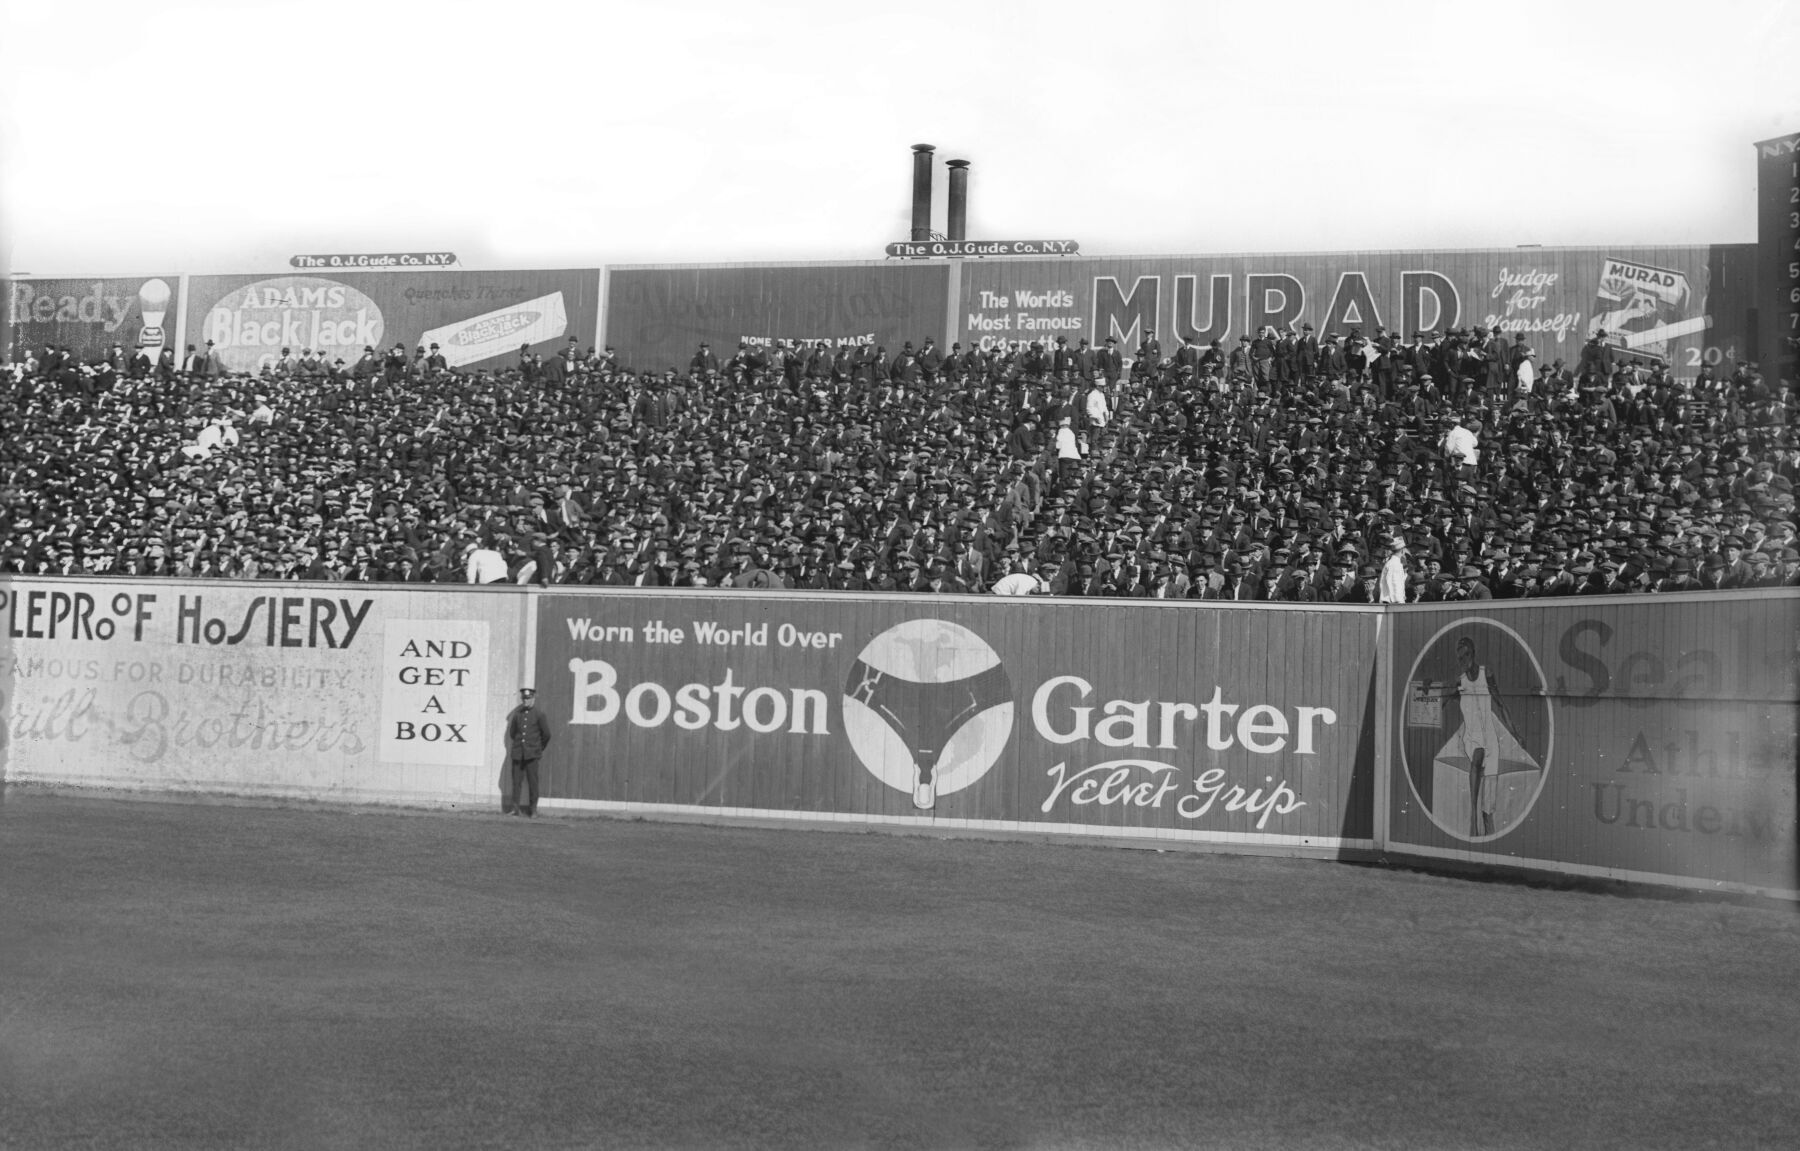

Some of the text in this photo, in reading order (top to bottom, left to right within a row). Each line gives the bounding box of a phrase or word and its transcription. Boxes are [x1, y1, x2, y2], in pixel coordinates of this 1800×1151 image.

[1789, 187, 1800, 203] 2
[1789, 212, 1800, 228] 3
[894, 243, 926, 255] The
[1043, 241, 1071, 253] N.Y.
[296, 256, 325, 267] The
[426, 254, 450, 265] N.Y.
[1788, 262, 1800, 279] 5
[1492, 267, 1559, 298] Judge
[1609, 264, 1676, 288] MURAD
[10, 282, 138, 332] Ready
[240, 286, 346, 309] ADAMS
[980, 290, 1073, 309] The World's
[1505, 289, 1546, 316] for
[1789, 288, 1800, 303] 6
[967, 312, 1082, 331] Most Famous
[1091, 271, 1461, 350] MURAD
[1789, 313, 1800, 329] 7
[211, 307, 303, 349] Black
[303, 309, 378, 350] Jack
[458, 324, 496, 346] Black
[498, 314, 530, 334] Jack
[1485, 311, 1580, 343] Yourself!
[741, 335, 772, 347] NONE
[837, 333, 875, 348] MADE
[567, 617, 842, 649] Worn the World Over
[400, 640, 473, 660] AND
[114, 661, 163, 685] FOR
[178, 662, 353, 690] DURABILITY
[398, 666, 471, 687] GET
[1552, 618, 1796, 713] Seal
[422, 696, 446, 714] A
[567, 657, 831, 736] Boston
[0, 687, 367, 763] rill Brothers
[1031, 675, 1337, 754] Garter
[395, 721, 468, 744] BOX
[1041, 758, 1307, 830] Velvet Grip
